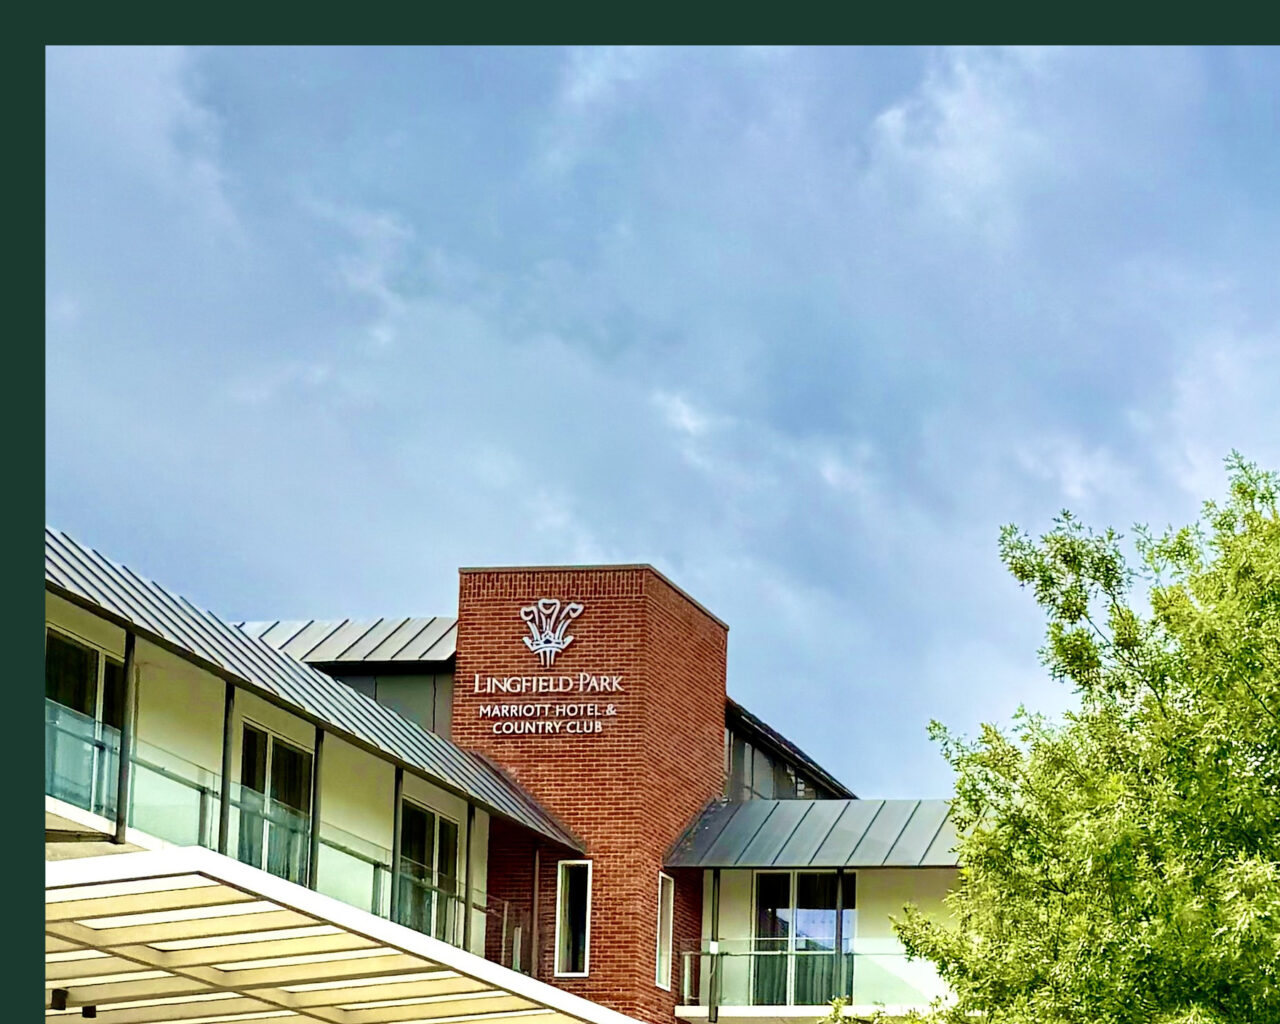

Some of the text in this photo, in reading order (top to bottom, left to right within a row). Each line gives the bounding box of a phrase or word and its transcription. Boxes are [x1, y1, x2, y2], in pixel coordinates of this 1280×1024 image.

[474, 672, 625, 693] LINGFIELD PARK
[479, 703, 617, 717] MARRIOTT HOTEL &
[492, 720, 603, 734] COUNTRY CLUB
